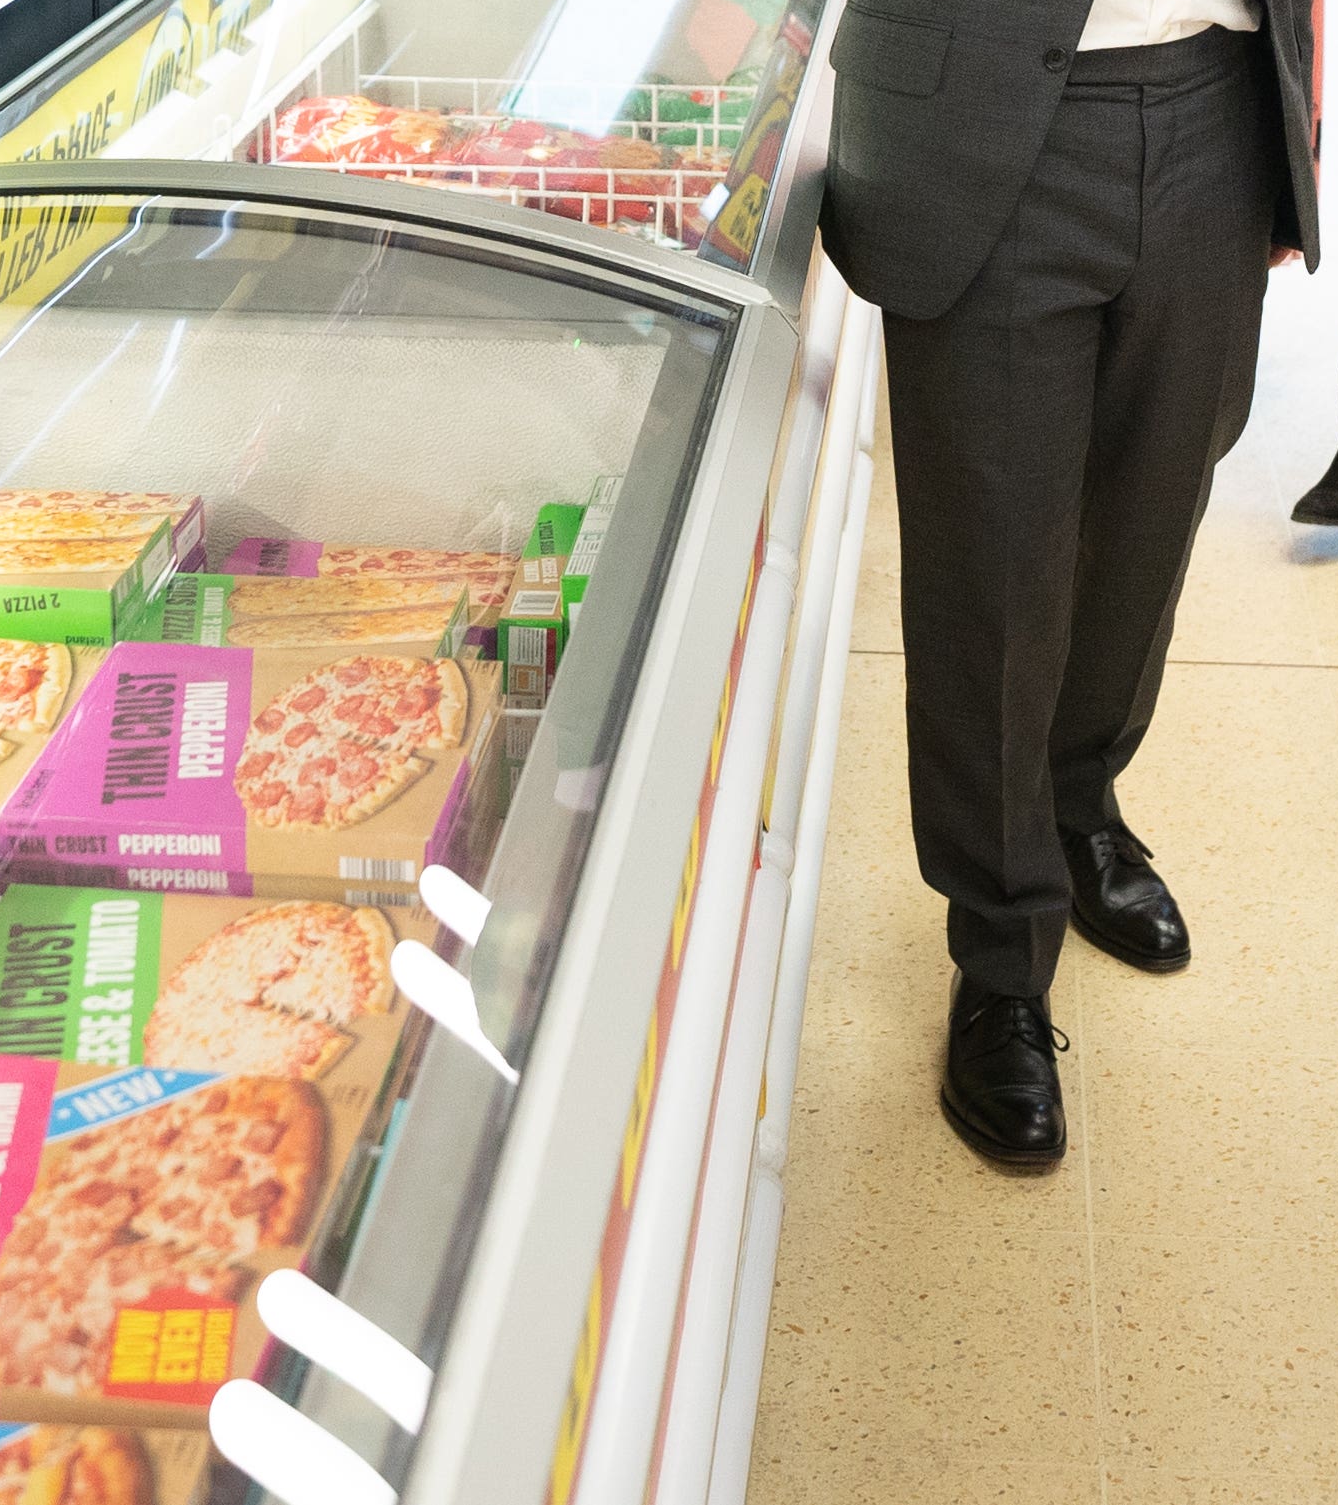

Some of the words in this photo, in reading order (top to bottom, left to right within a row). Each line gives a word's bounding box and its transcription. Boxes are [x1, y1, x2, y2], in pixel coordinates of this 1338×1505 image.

[5, 594, 48, 614] PIZZA
[51, 592, 61, 609] 2
[162, 605, 196, 641] PIZZA
[109, 671, 178, 742] CRUST
[177, 680, 229, 780] PEPPERONI
[100, 745, 170, 806] THIN
[118, 833, 222, 857] PEPPERONI
[127, 867, 229, 890] PEPPERONI
[83, 899, 141, 988] TOMATO
[79, 988, 135, 1012] &
[70, 1070, 164, 1123] NEW
[109, 1308, 162, 1385] NOW
[154, 1308, 204, 1384] EVEN
